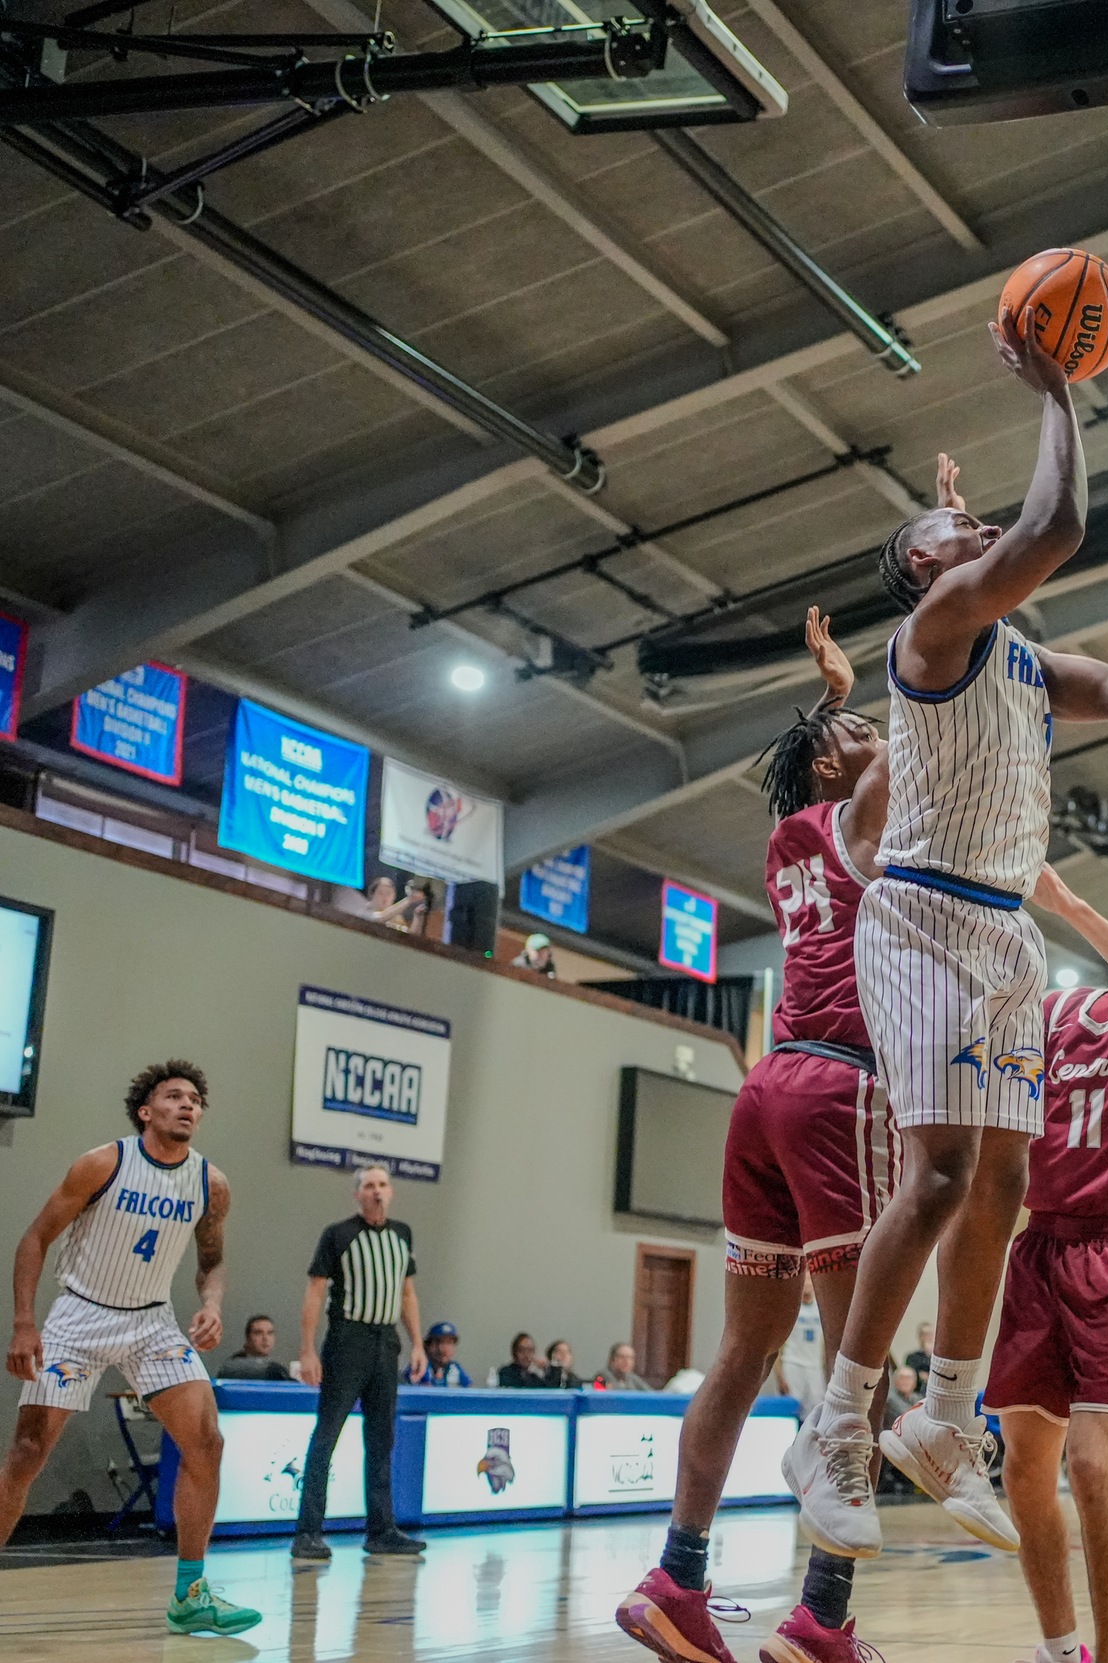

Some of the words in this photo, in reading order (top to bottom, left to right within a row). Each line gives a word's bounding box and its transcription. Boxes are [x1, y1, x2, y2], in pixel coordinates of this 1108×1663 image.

[777, 853, 835, 948] 24
[324, 1049, 419, 1114] NCCAA
[1067, 1088, 1105, 1148] 11
[115, 1188, 195, 1224] FALCONS
[132, 1229, 160, 1263] 4
